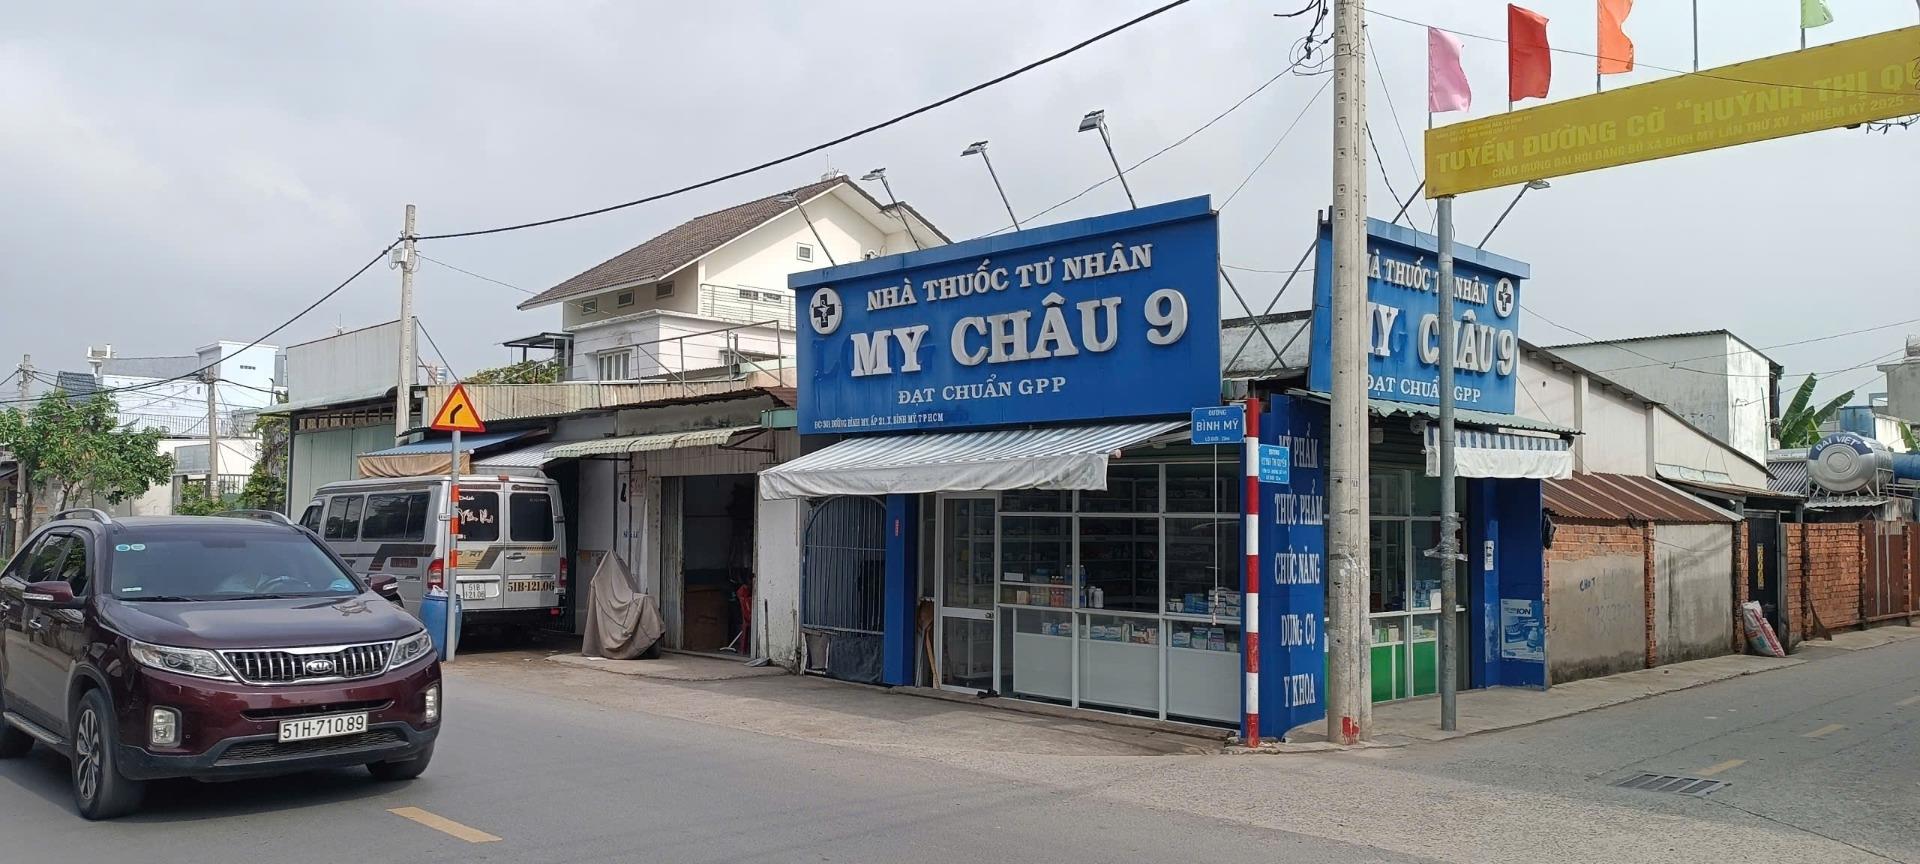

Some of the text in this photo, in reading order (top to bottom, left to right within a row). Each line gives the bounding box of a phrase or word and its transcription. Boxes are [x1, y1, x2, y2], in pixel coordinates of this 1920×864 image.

[1436, 137, 1515, 172] TUYẾN
[1523, 120, 1616, 157] ĐƯỜNG
[1626, 107, 1666, 137] CỜ
[866, 242, 1153, 311] NHÀ THUỐC TƯ NHÂN
[1385, 256, 1431, 291] THUỐC
[1453, 275, 1489, 305] NHÂN
[851, 288, 1189, 377] MY CHÂU 9
[1496, 329, 1515, 376] 9
[898, 373, 1066, 406] ĐẠT CHUẨN GPP
[1453, 386, 1481, 403] GPP
[1196, 418, 1239, 432] BÌNH MỸ
[1293, 421, 1319, 468] PHẨM
[1299, 477, 1323, 526] PHẨM
[1274, 544, 1298, 585] CHỨC
[507, 580, 555, 592] 51B-121.06
[1281, 613, 1316, 653] DỤNG CỤ
[309, 661, 330, 671] KIA
[1283, 672, 1316, 708] Y KHOA
[282, 715, 364, 739] 51H-710.89
